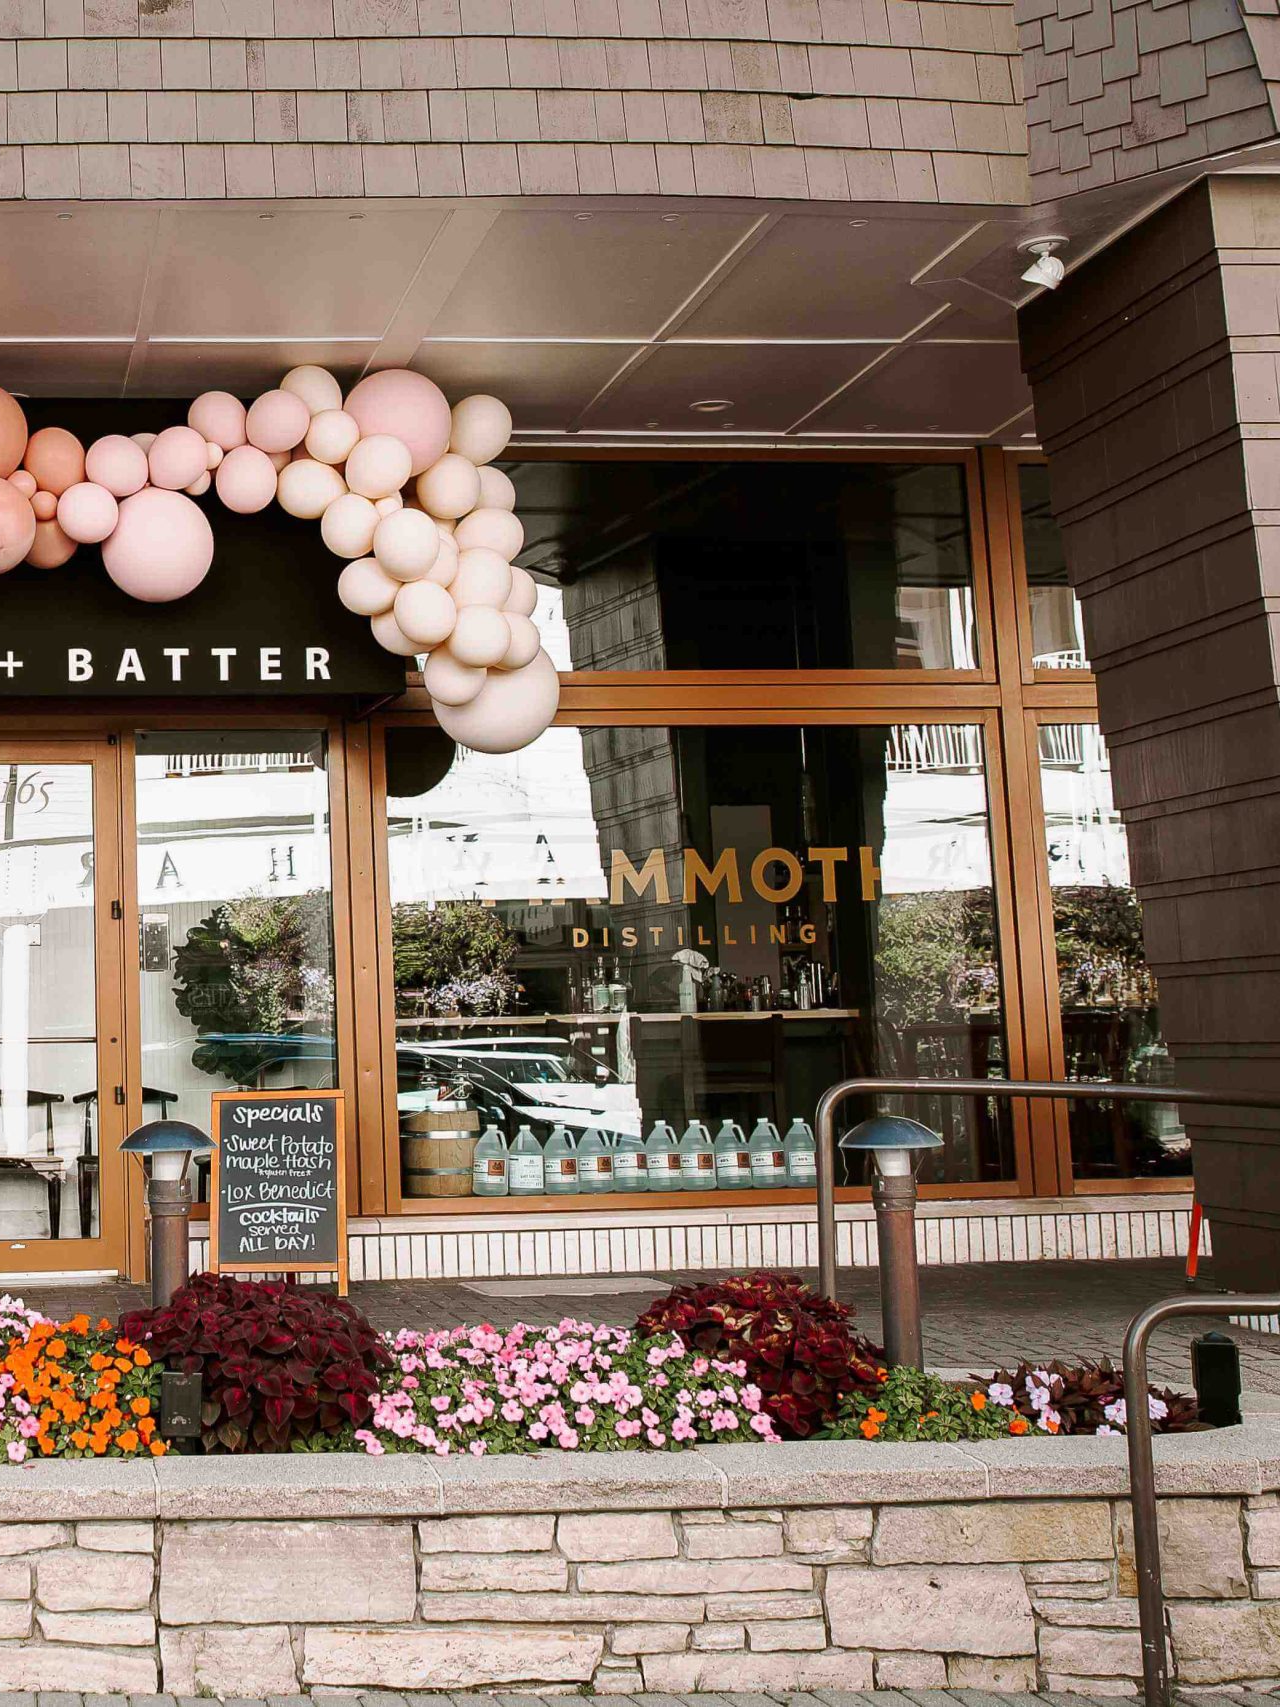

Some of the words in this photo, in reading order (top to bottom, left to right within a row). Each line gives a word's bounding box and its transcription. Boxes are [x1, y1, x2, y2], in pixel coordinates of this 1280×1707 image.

[67, 647, 331, 682] BATTER
[482, 845, 881, 907] MMOTH
[573, 923, 817, 949] DISTILLING
[281, 1134, 334, 1156] Potato
[227, 1184, 256, 1204] Lox
[259, 1180, 336, 1201] Benedict
[239, 1236, 269, 1253] ALL
